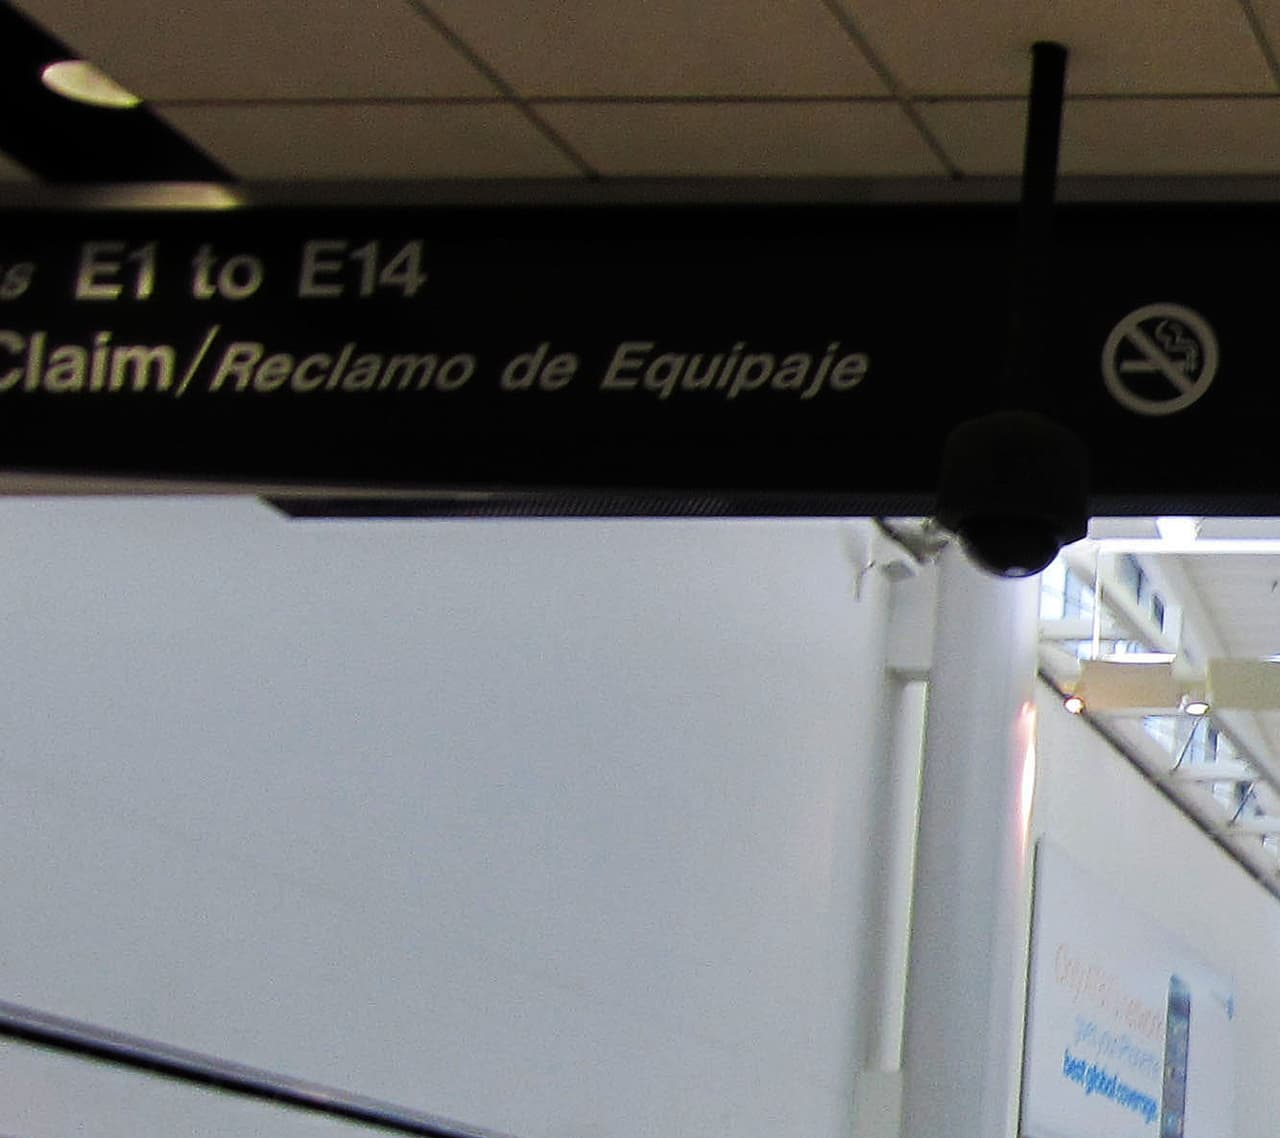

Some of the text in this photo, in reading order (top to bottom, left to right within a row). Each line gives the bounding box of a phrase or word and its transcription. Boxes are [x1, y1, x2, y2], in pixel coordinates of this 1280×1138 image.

[76, 240, 158, 300] E1
[192, 243, 263, 300] to
[299, 239, 427, 298] E14
[500, 341, 578, 391] de
[601, 341, 869, 400] Equipaje
